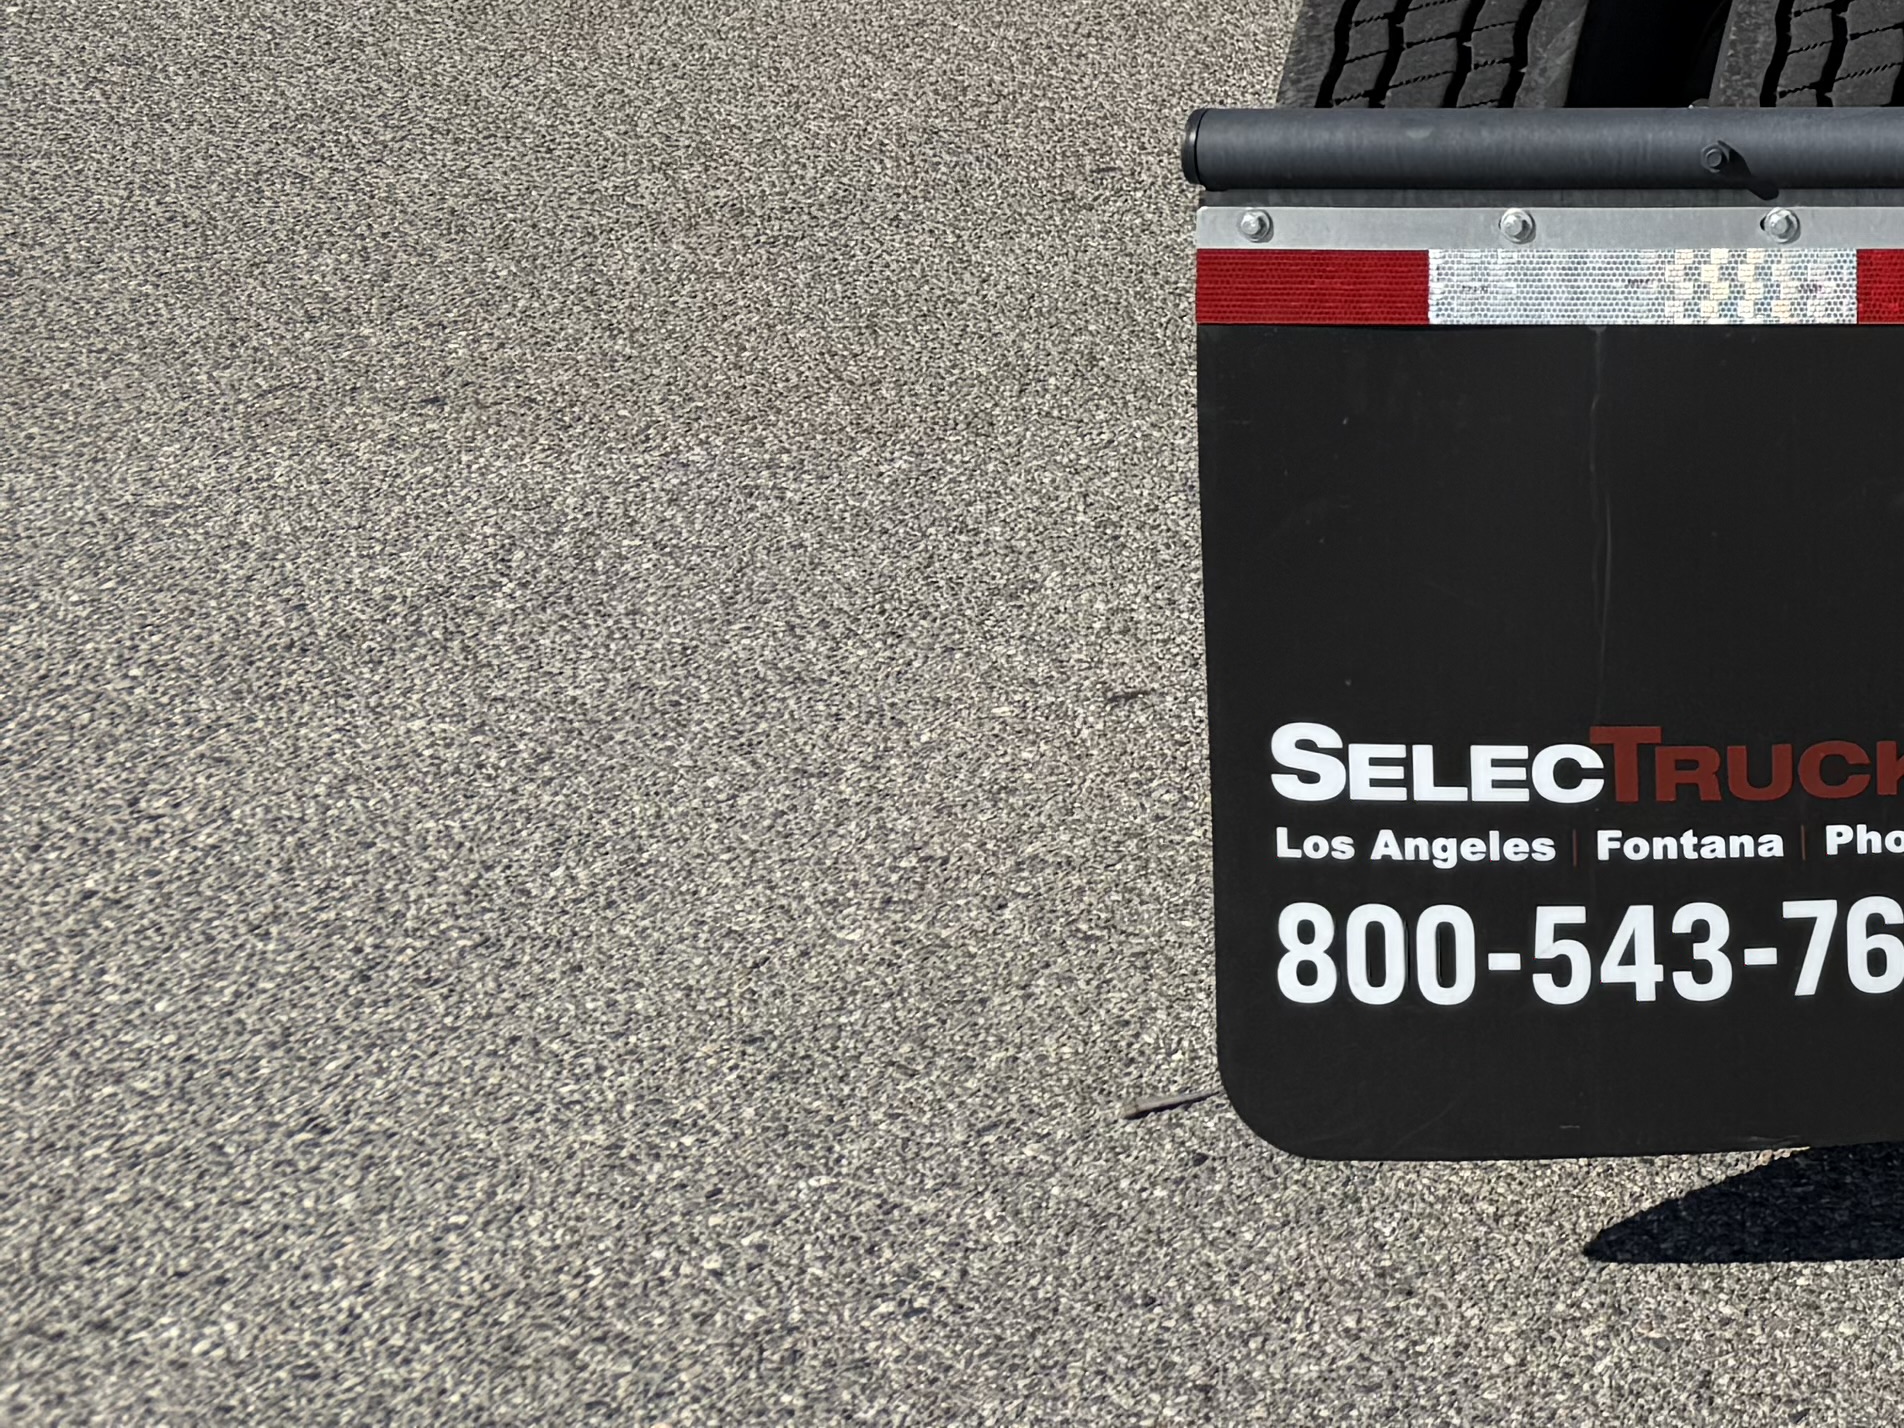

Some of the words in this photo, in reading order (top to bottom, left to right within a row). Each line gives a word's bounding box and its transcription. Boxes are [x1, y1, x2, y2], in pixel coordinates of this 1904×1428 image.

[1275, 826, 1356, 861] Los
[1370, 828, 1557, 869] Angeles
[1596, 828, 1785, 861] Fontana
